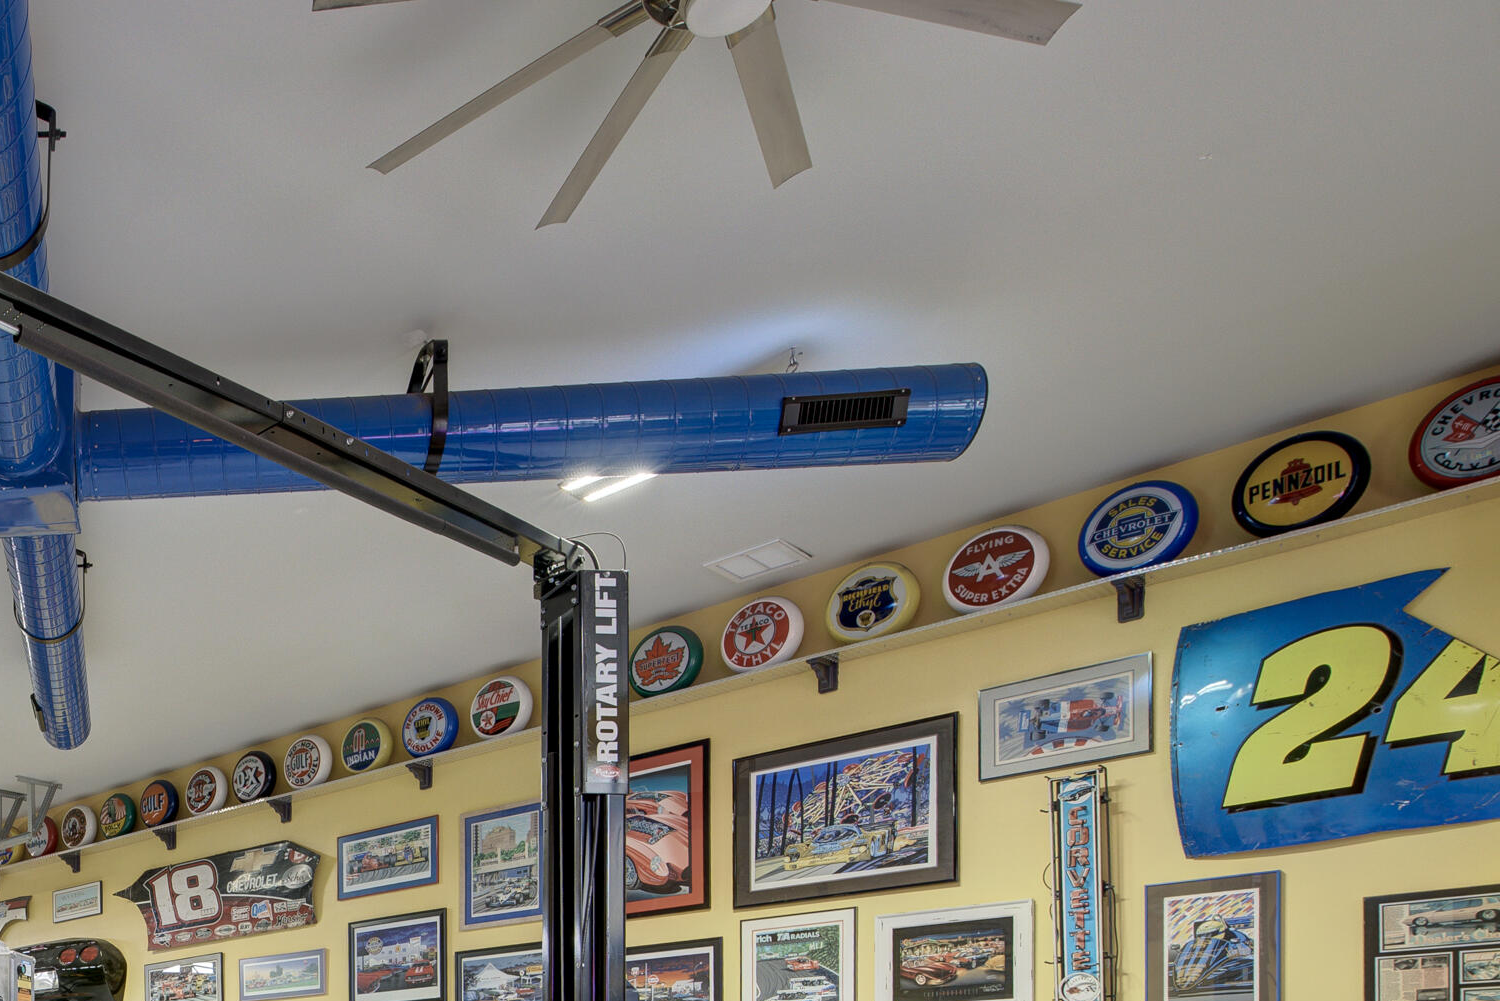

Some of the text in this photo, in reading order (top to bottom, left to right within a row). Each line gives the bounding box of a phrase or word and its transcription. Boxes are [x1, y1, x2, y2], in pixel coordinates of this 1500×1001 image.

[1249, 461, 1346, 504] PENNZOIL
[1108, 496, 1157, 519] SALES
[1093, 513, 1172, 543] CHEVROLET
[966, 535, 1015, 557] FLYING
[1101, 530, 1164, 560] SERVICE
[954, 566, 1030, 604] SUPER EXTRA
[848, 593, 882, 613] Ethyl
[727, 602, 787, 635] TEXACO
[740, 617, 770, 632] TEXACO
[731, 640, 785, 667] ETHYL
[594, 572, 619, 762] ROTARY LIFT
[476, 686, 514, 711] Sky Chief
[405, 709, 419, 731] RED
[419, 703, 445, 721] CROWN
[1221, 622, 1500, 814] 24
[406, 729, 444, 753] GASOLINE
[291, 752, 311, 770] GULF
[307, 758, 319, 780] FUEL
[346, 750, 377, 768] INDIAN
[141, 792, 165, 814] GULF
[104, 823, 121, 832] POLLY
[148, 861, 222, 930] 18
[226, 873, 279, 894] CHEVROLET
[1066, 805, 1092, 972] CORVETTE
[755, 934, 773, 943] rich
[790, 930, 821, 940] RADIALS
